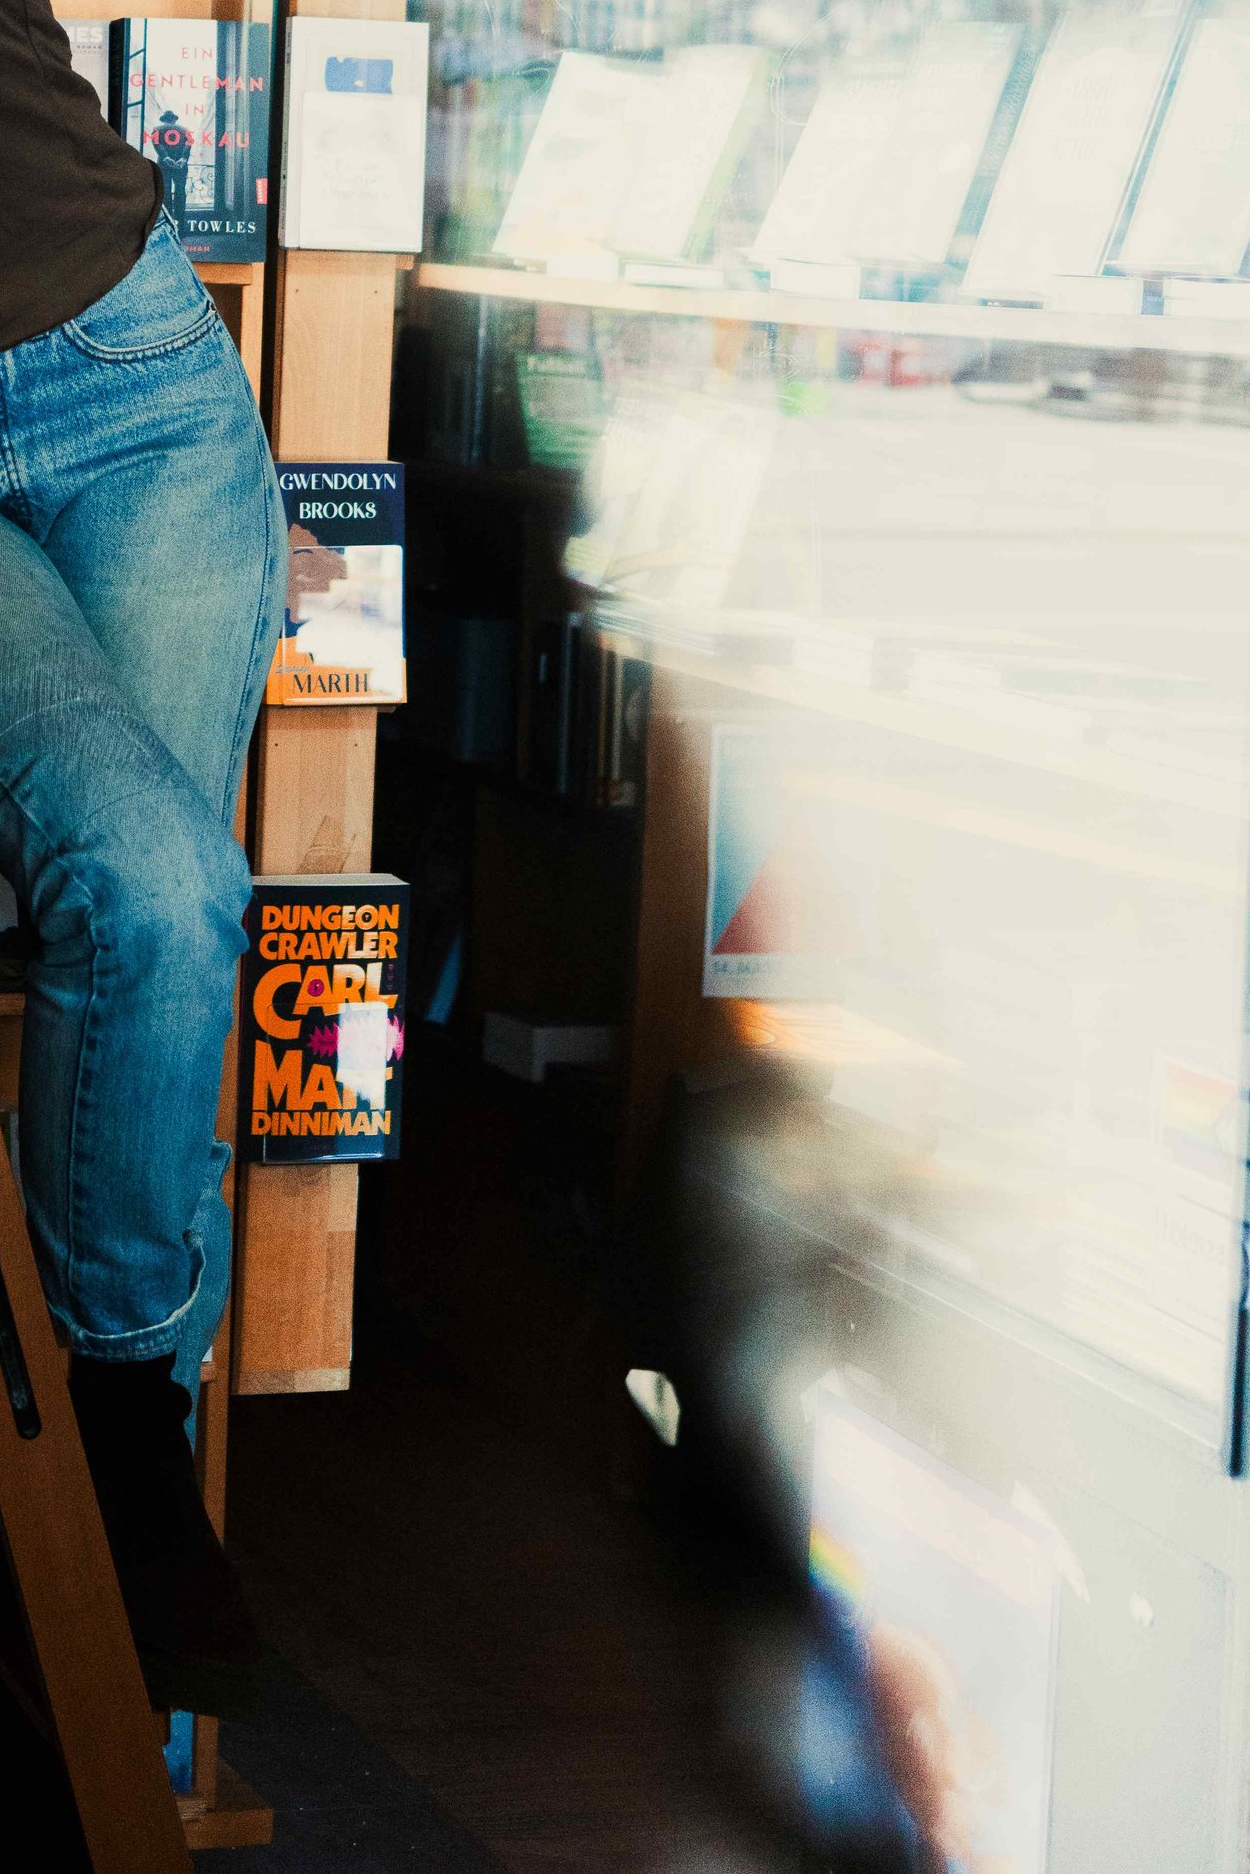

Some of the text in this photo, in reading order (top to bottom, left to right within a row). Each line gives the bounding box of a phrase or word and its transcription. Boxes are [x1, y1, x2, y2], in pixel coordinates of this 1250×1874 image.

[180, 46, 213, 61] EIN
[130, 73, 264, 92] GENTLEMAN
[184, 104, 204, 116] IN
[142, 128, 250, 148] MOSKAU
[188, 218, 257, 234] TOWLES
[280, 472, 397, 490] GWENDOLYN
[300, 502, 377, 520] BROOKS
[262, 904, 399, 931] DUNGEON
[258, 931, 398, 960] CRAWLER
[253, 962, 398, 1040] CARL
[251, 1110, 391, 1136] DINNIMAN
